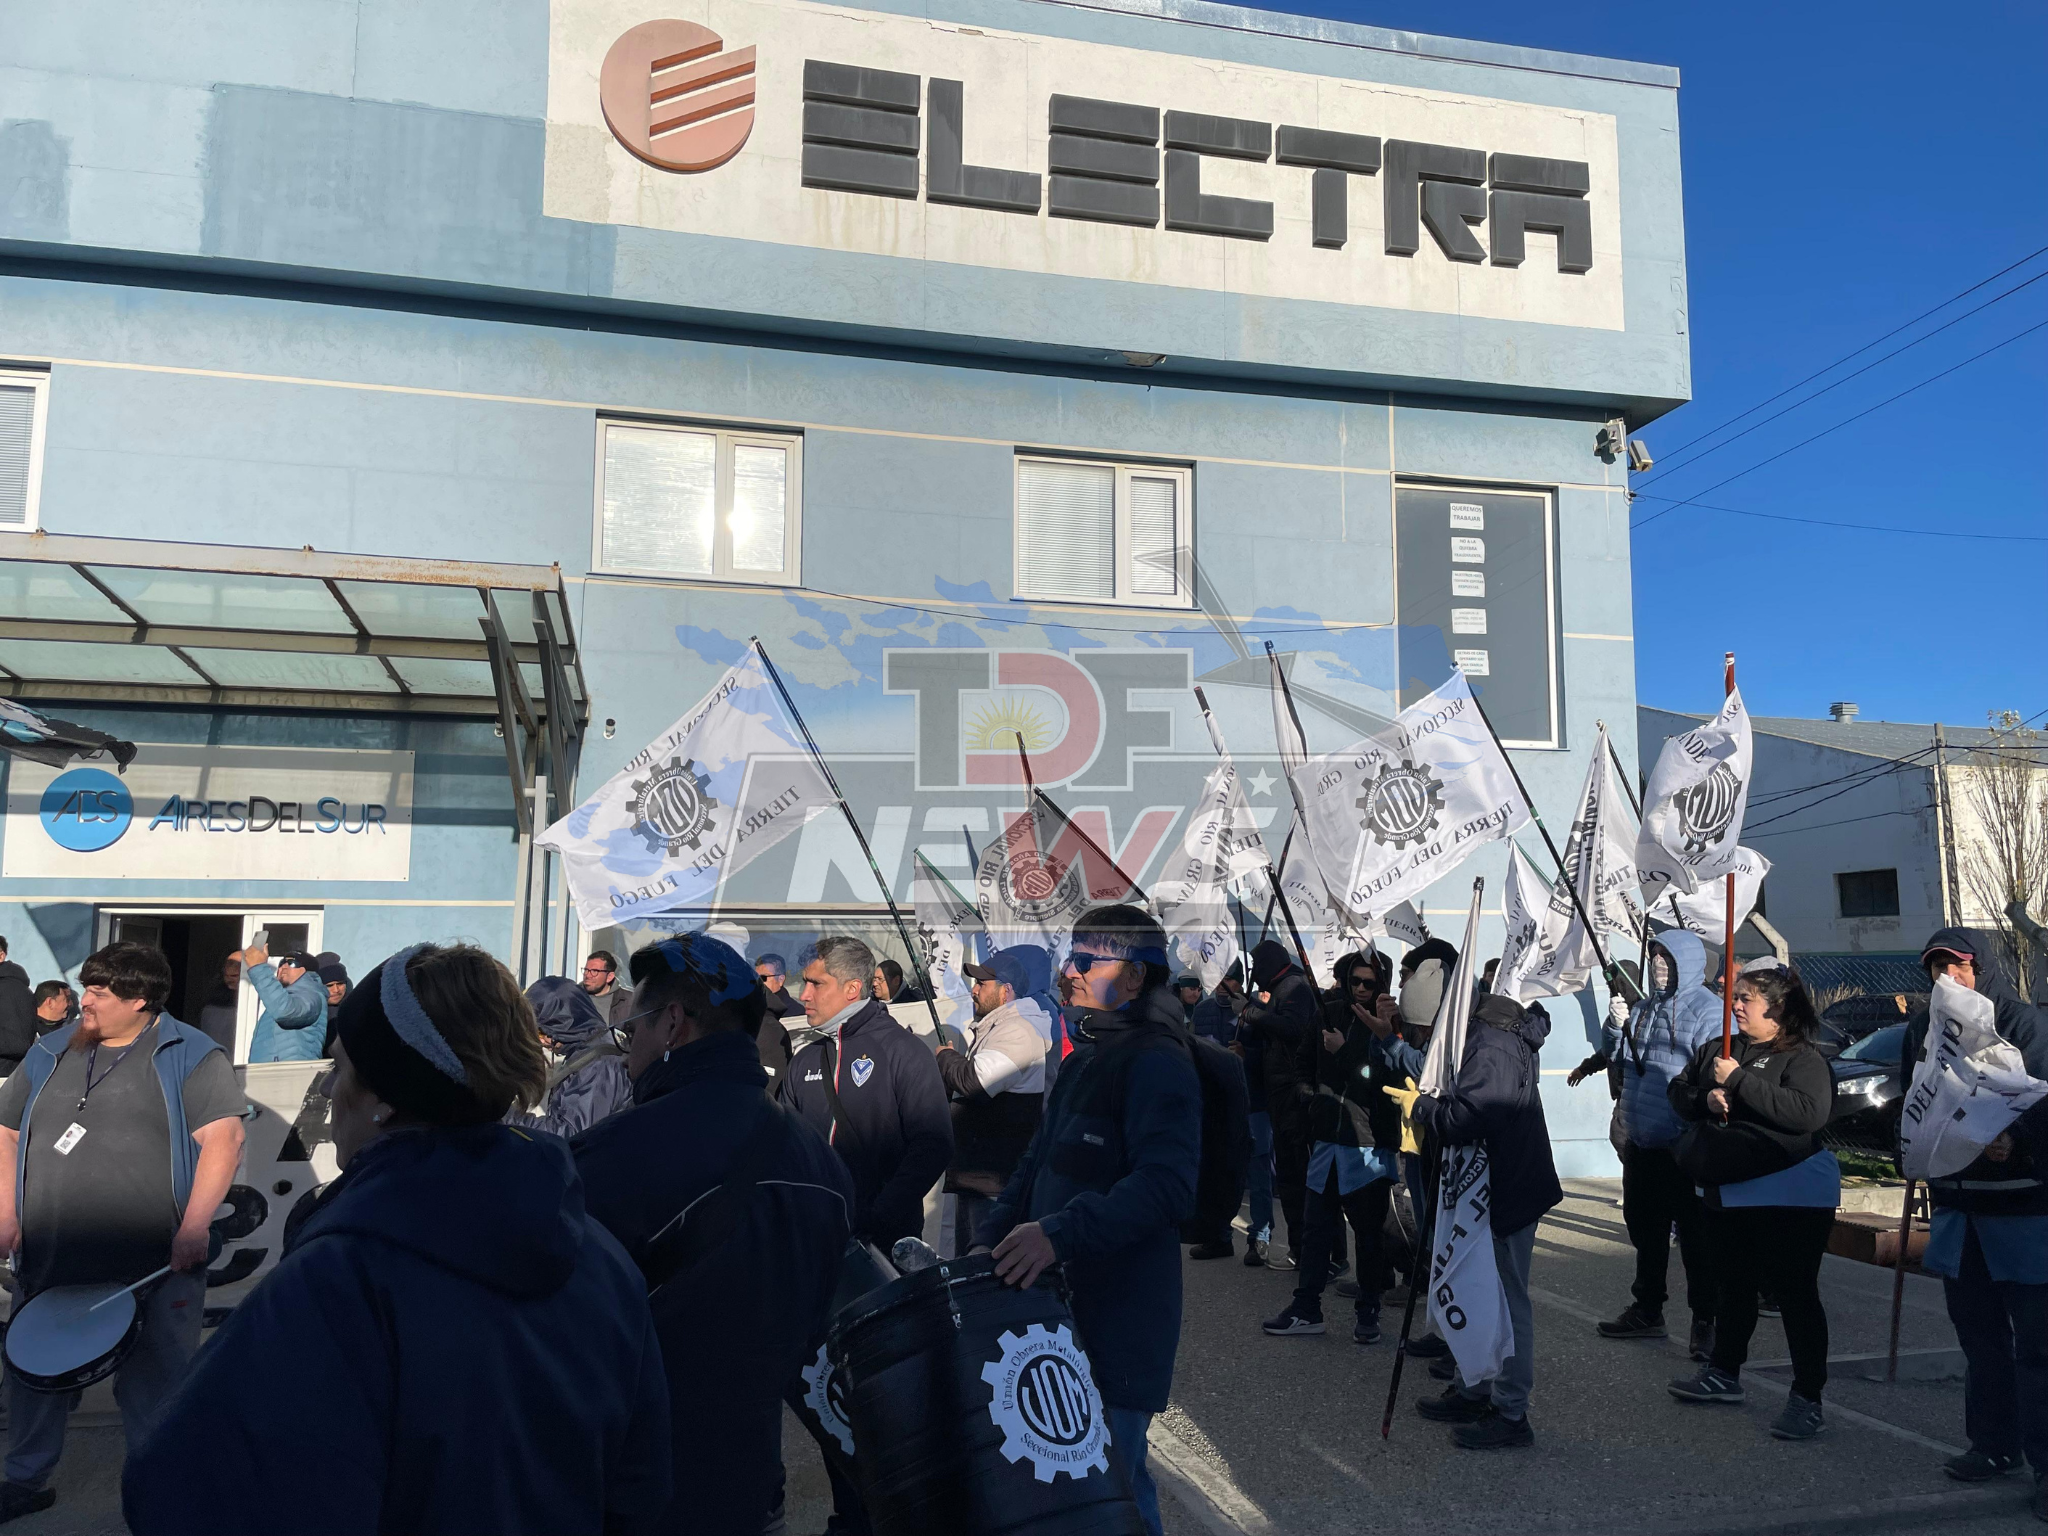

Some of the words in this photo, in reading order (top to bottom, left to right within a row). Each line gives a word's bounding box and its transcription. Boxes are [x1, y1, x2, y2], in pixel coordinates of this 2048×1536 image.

[802, 59, 1593, 275] ELECTRA
[1451, 505, 1481, 513] QUEREMOS
[1905, 1082, 1938, 1125] DEL
[1003, 1369, 1016, 1411] Unión
[1011, 1341, 1045, 1367] Obrera
[1021, 1433, 1070, 1463] Seccional
